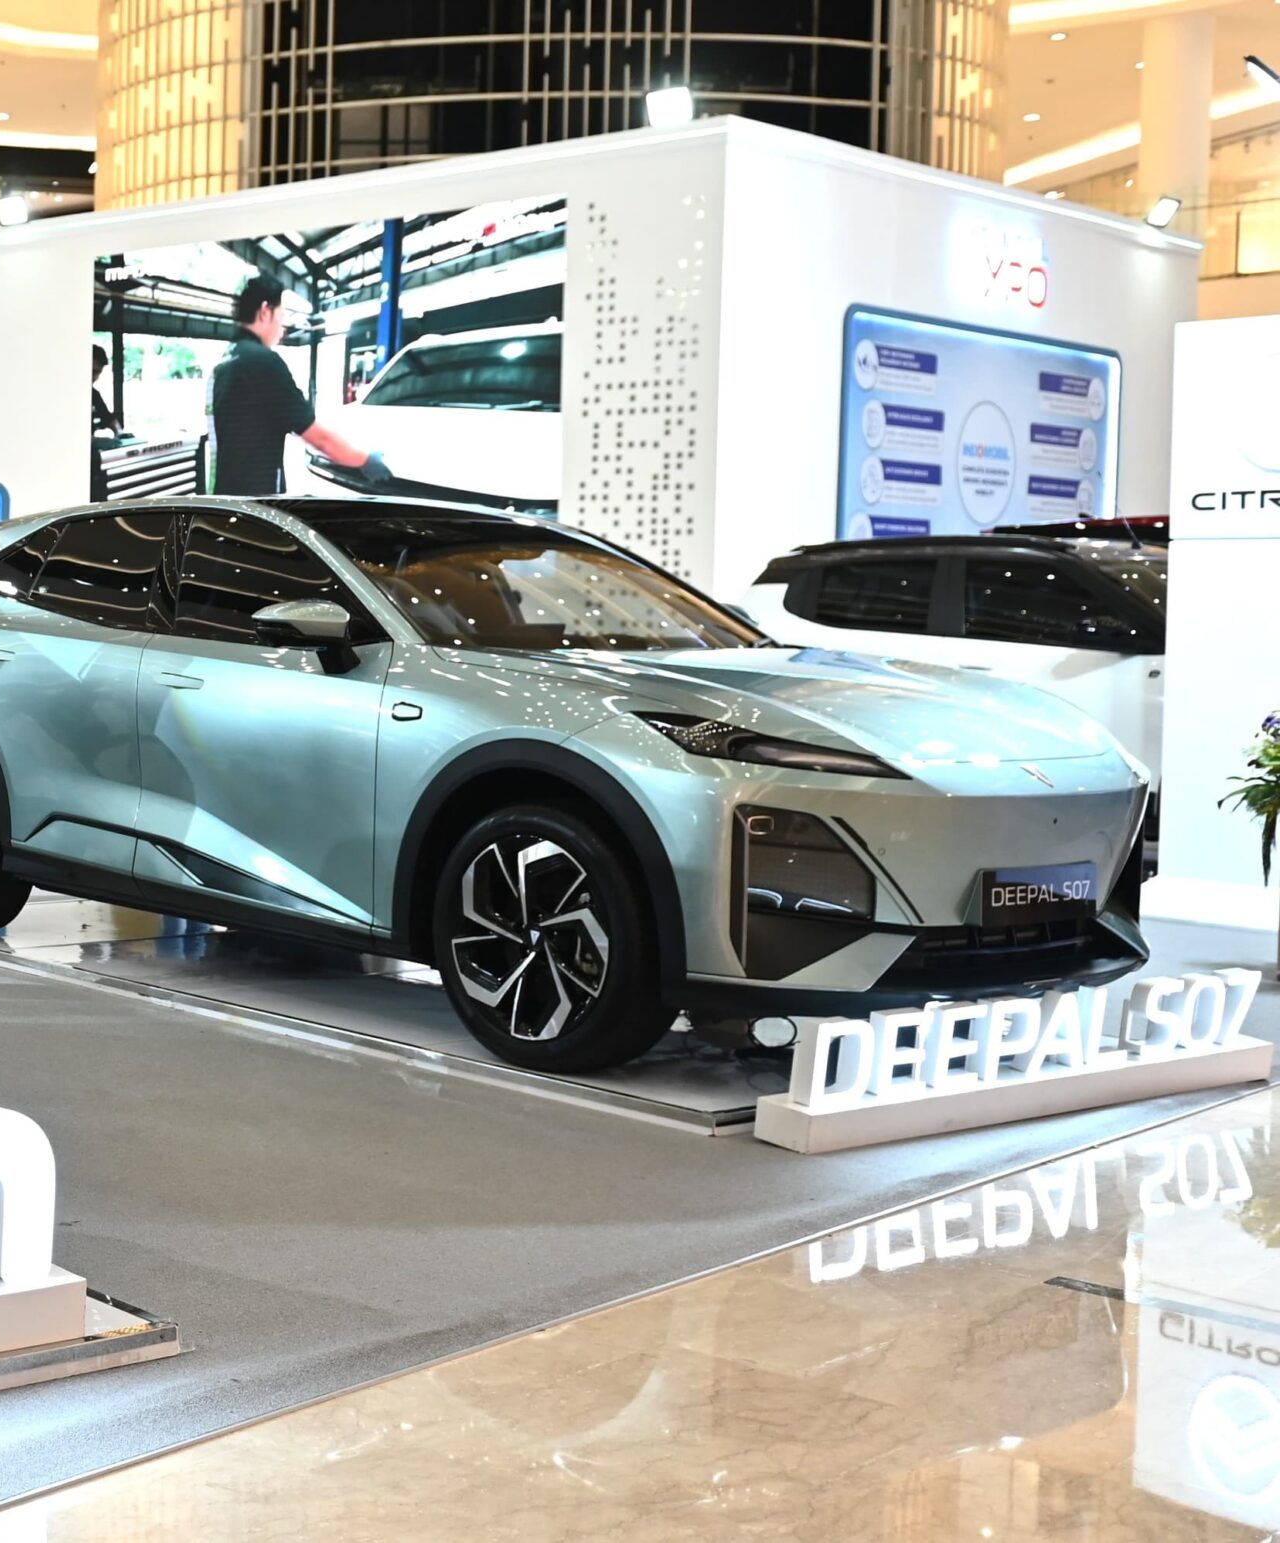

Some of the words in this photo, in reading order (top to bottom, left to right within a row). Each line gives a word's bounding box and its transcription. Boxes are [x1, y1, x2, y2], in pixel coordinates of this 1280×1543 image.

[990, 884, 1059, 908] DEEPAL
[1062, 880, 1091, 901] S07
[800, 984, 1128, 1108] DEEPAL
[1132, 967, 1263, 1055] S07
